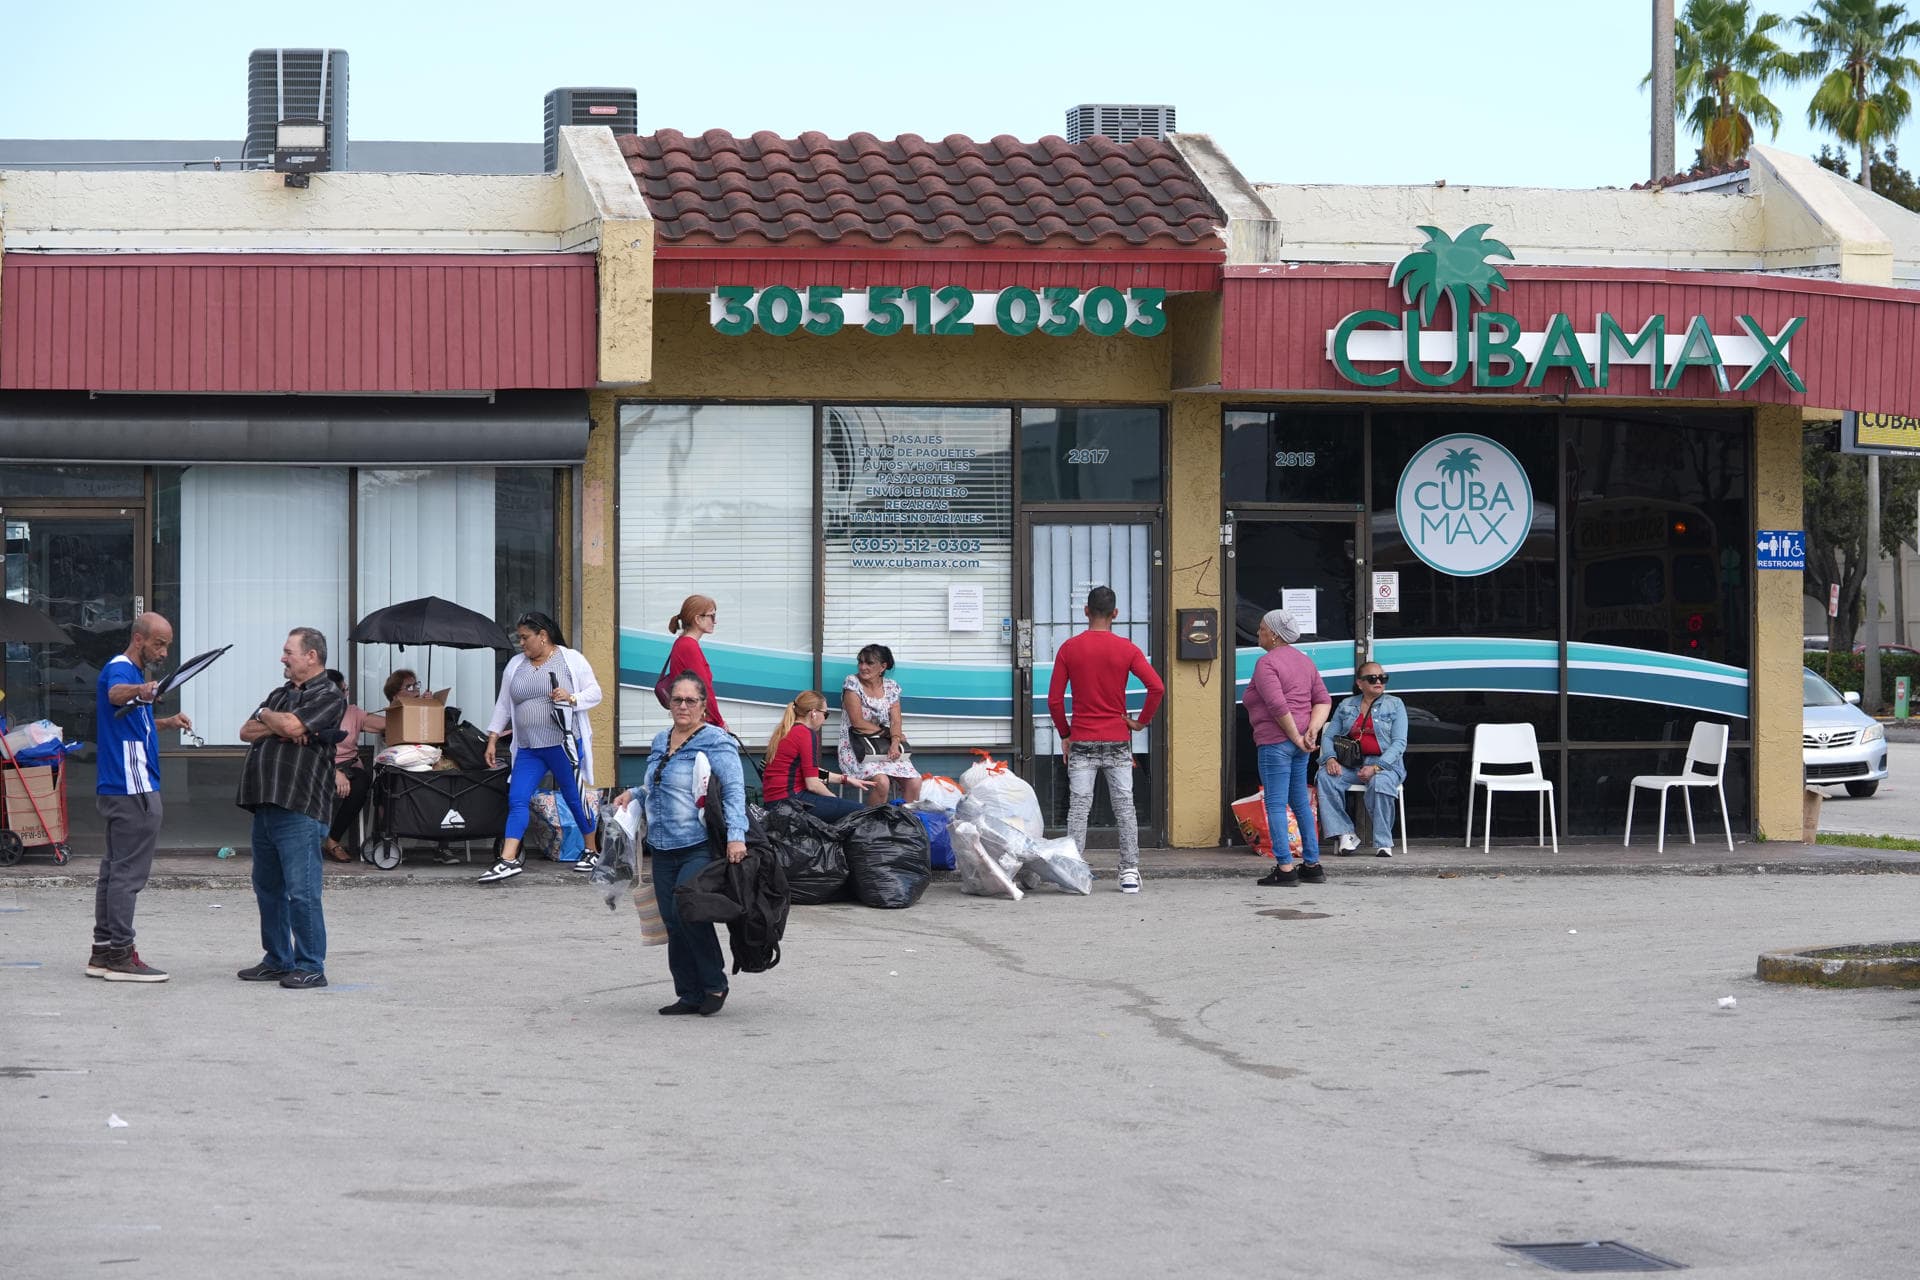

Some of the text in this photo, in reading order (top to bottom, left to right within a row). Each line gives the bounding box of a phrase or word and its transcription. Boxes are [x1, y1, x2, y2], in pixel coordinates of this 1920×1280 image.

[712, 285, 1167, 337] 305 512 0303
[1331, 309, 1807, 393] CUBAMAX
[1862, 411, 1920, 430] CUBA
[892, 435, 943, 445] PASAJES
[897, 447, 913, 457] DE
[916, 448, 976, 458] PAQUETES
[1068, 449, 1110, 464] 2817
[1275, 452, 1316, 467] 2815
[864, 460, 970, 472] AUTOS Y HOTELES
[879, 473, 957, 484] PASAPORTES
[865, 484, 969, 498] ENVÍO DE DINERO
[1414, 480, 1515, 511] CUBA
[885, 499, 950, 510] RECARGAS
[850, 509, 984, 524] TRÁMITES NOTARIALES
[1420, 513, 1508, 545] MAX
[851, 538, 981, 553] (305) 512-0303
[852, 557, 980, 568] www.cubamax.com
[1758, 560, 1804, 568] RESTROOMS
